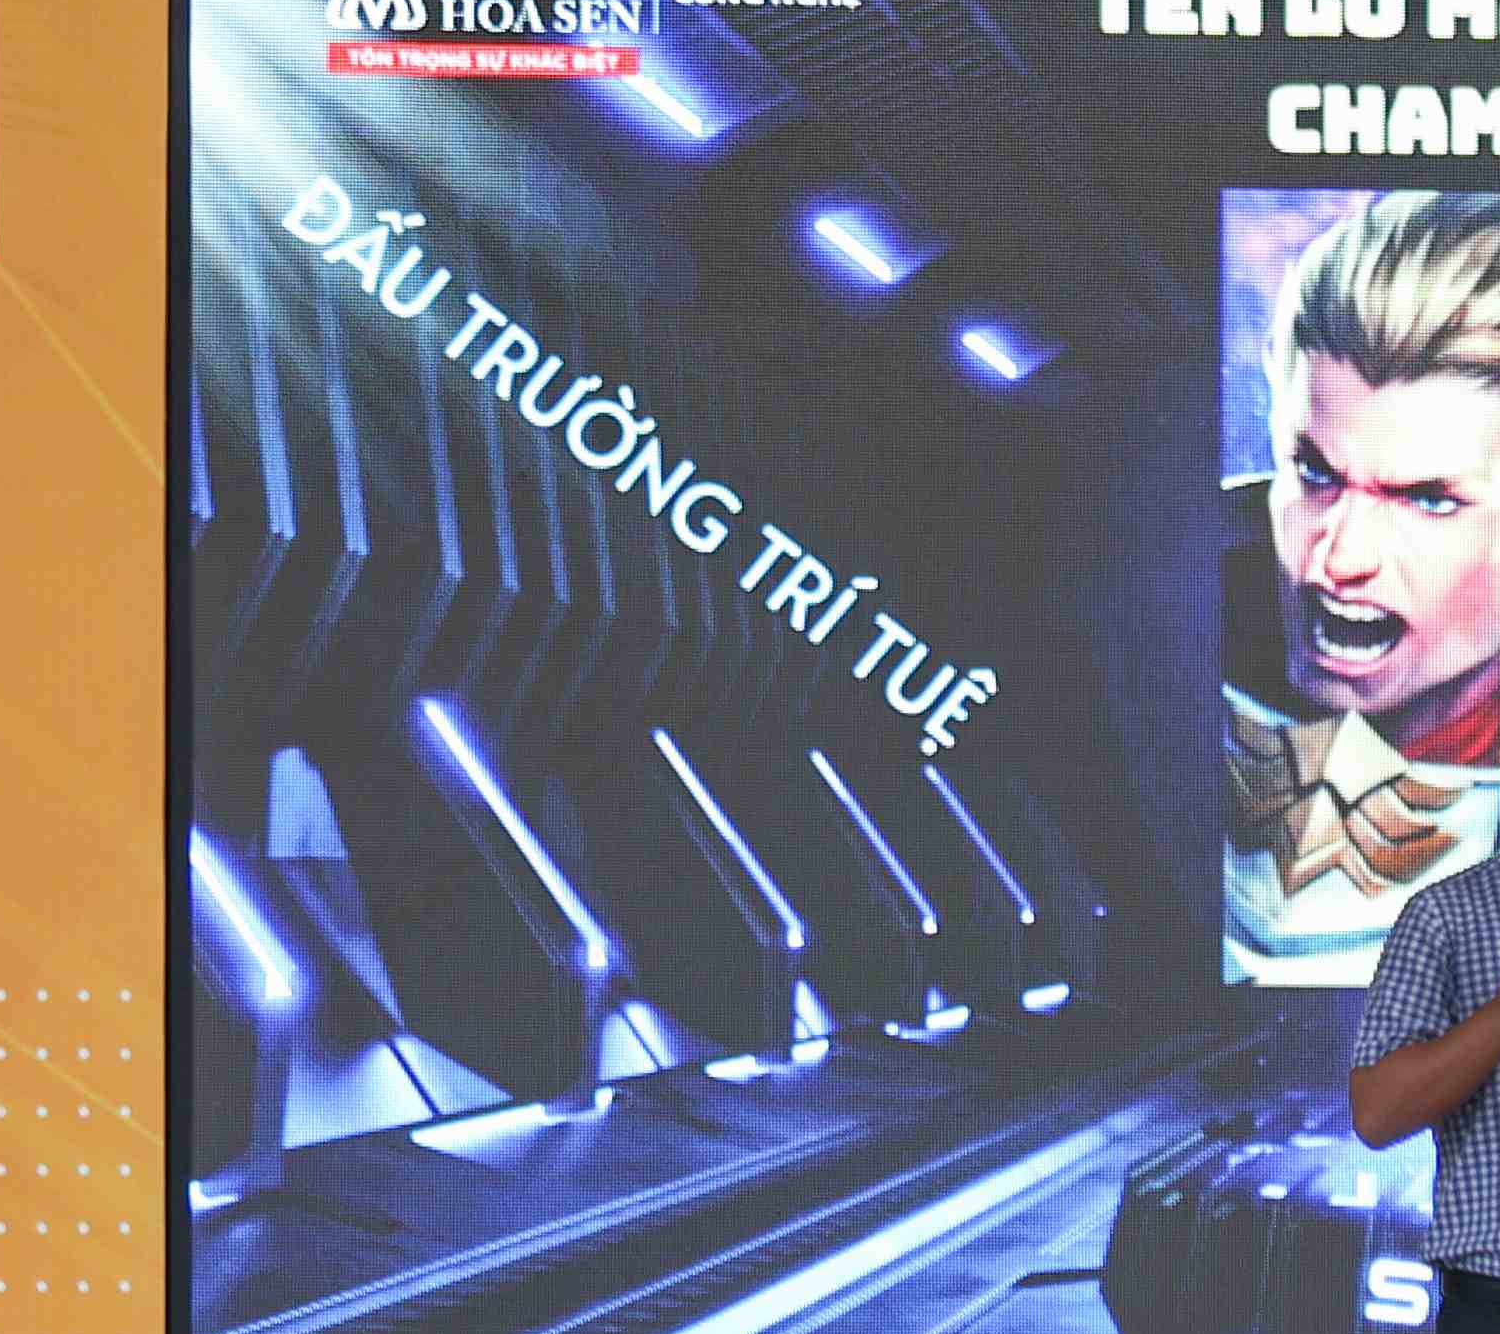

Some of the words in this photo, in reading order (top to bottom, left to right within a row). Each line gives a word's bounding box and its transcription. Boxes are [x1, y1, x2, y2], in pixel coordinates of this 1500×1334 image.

[281, 176, 452, 320] ĐẤU
[444, 293, 744, 554] TRƯỜNG
[739, 523, 880, 646] TRÍ
[852, 611, 999, 758] TUỆ
